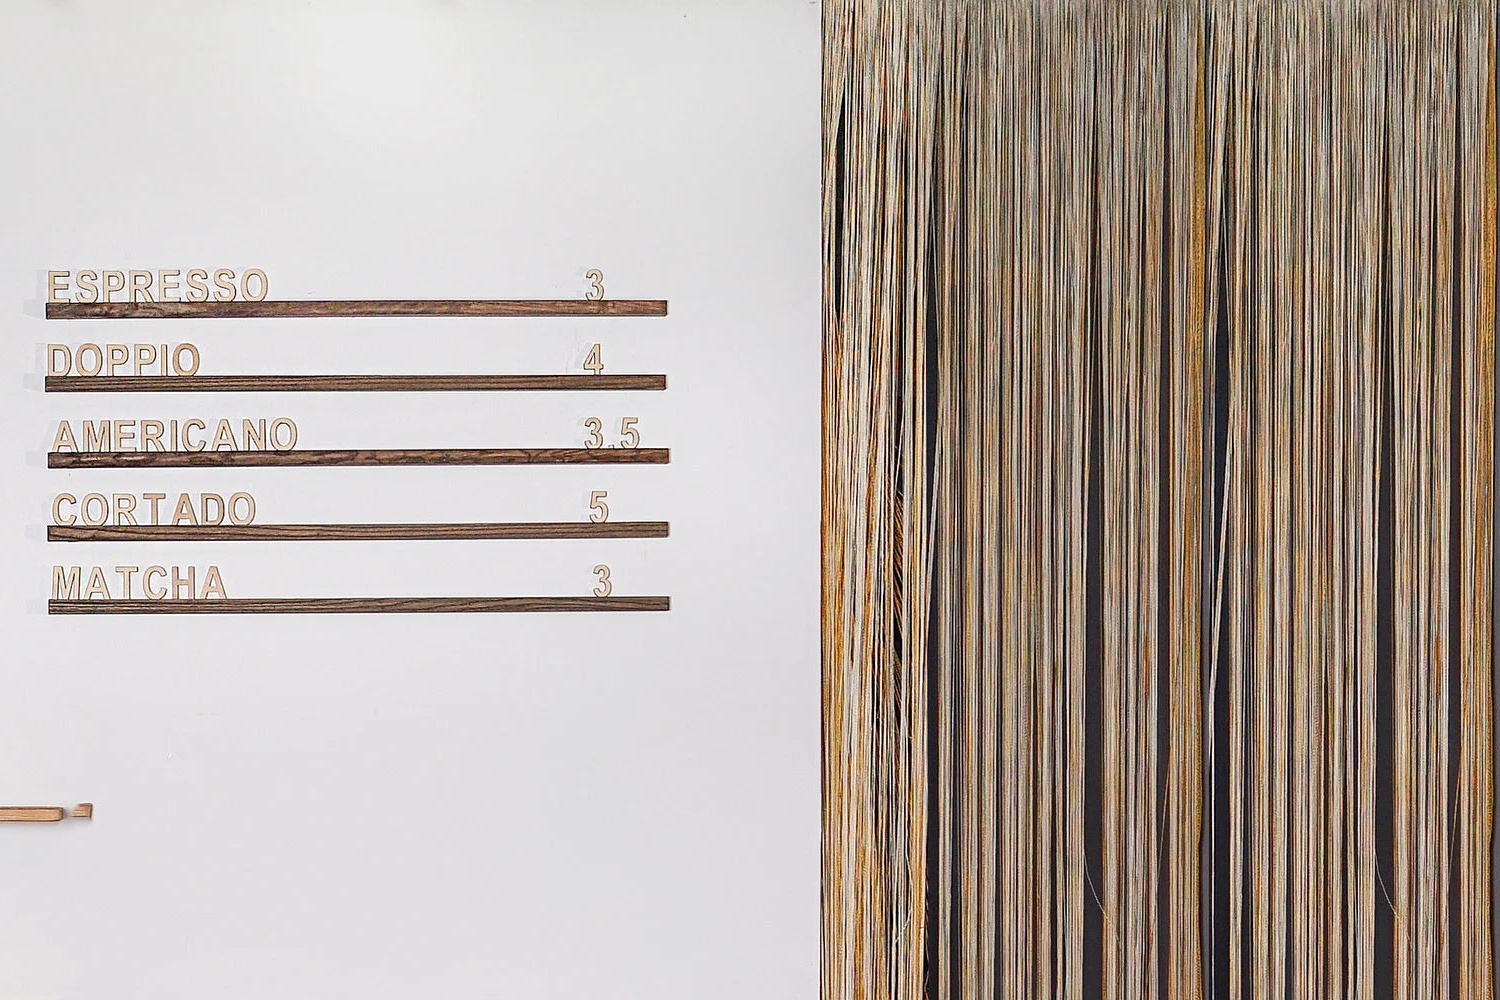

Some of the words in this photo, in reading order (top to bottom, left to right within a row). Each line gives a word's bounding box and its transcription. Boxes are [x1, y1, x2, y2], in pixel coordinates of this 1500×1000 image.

[47, 268, 269, 304] ESPRESSO
[585, 268, 605, 302] 3
[47, 342, 201, 377] DOPPIO
[584, 344, 604, 376] 4
[52, 417, 298, 452] AMERICANO
[584, 416, 640, 450] 3.5
[51, 492, 256, 527] CORTADO
[589, 491, 609, 523] 5
[51, 565, 227, 600] MATCHA
[592, 564, 612, 598] 3
